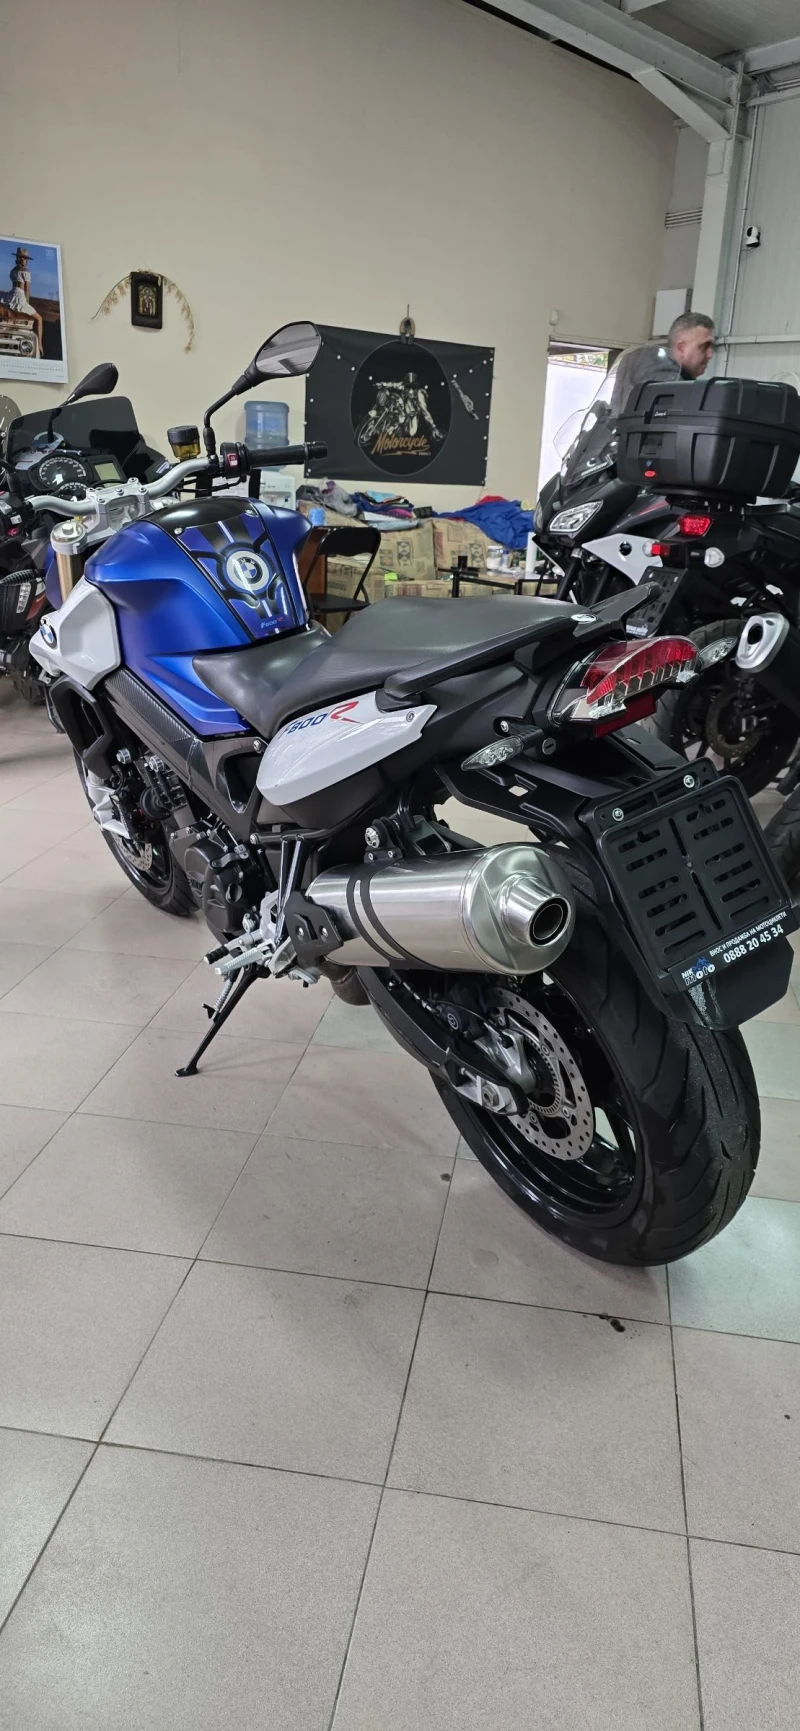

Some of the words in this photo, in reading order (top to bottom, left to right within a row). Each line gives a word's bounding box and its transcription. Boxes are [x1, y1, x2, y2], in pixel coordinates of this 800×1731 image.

[371, 431, 431, 455] Motorcycle
[709, 945, 723, 957] ВНОС
[725, 931, 751, 948] ПРОДАЖБА
[749, 926, 757, 936] НА
[755, 911, 788, 932] МОТОЦИКЛЕТИ
[723, 945, 747, 964] 0888
[746, 937, 760, 951] 20
[760, 931, 772, 943] 45
[770, 923, 784, 938] 34
[681, 967, 694, 980] NIK
[684, 964, 716, 987] moto
